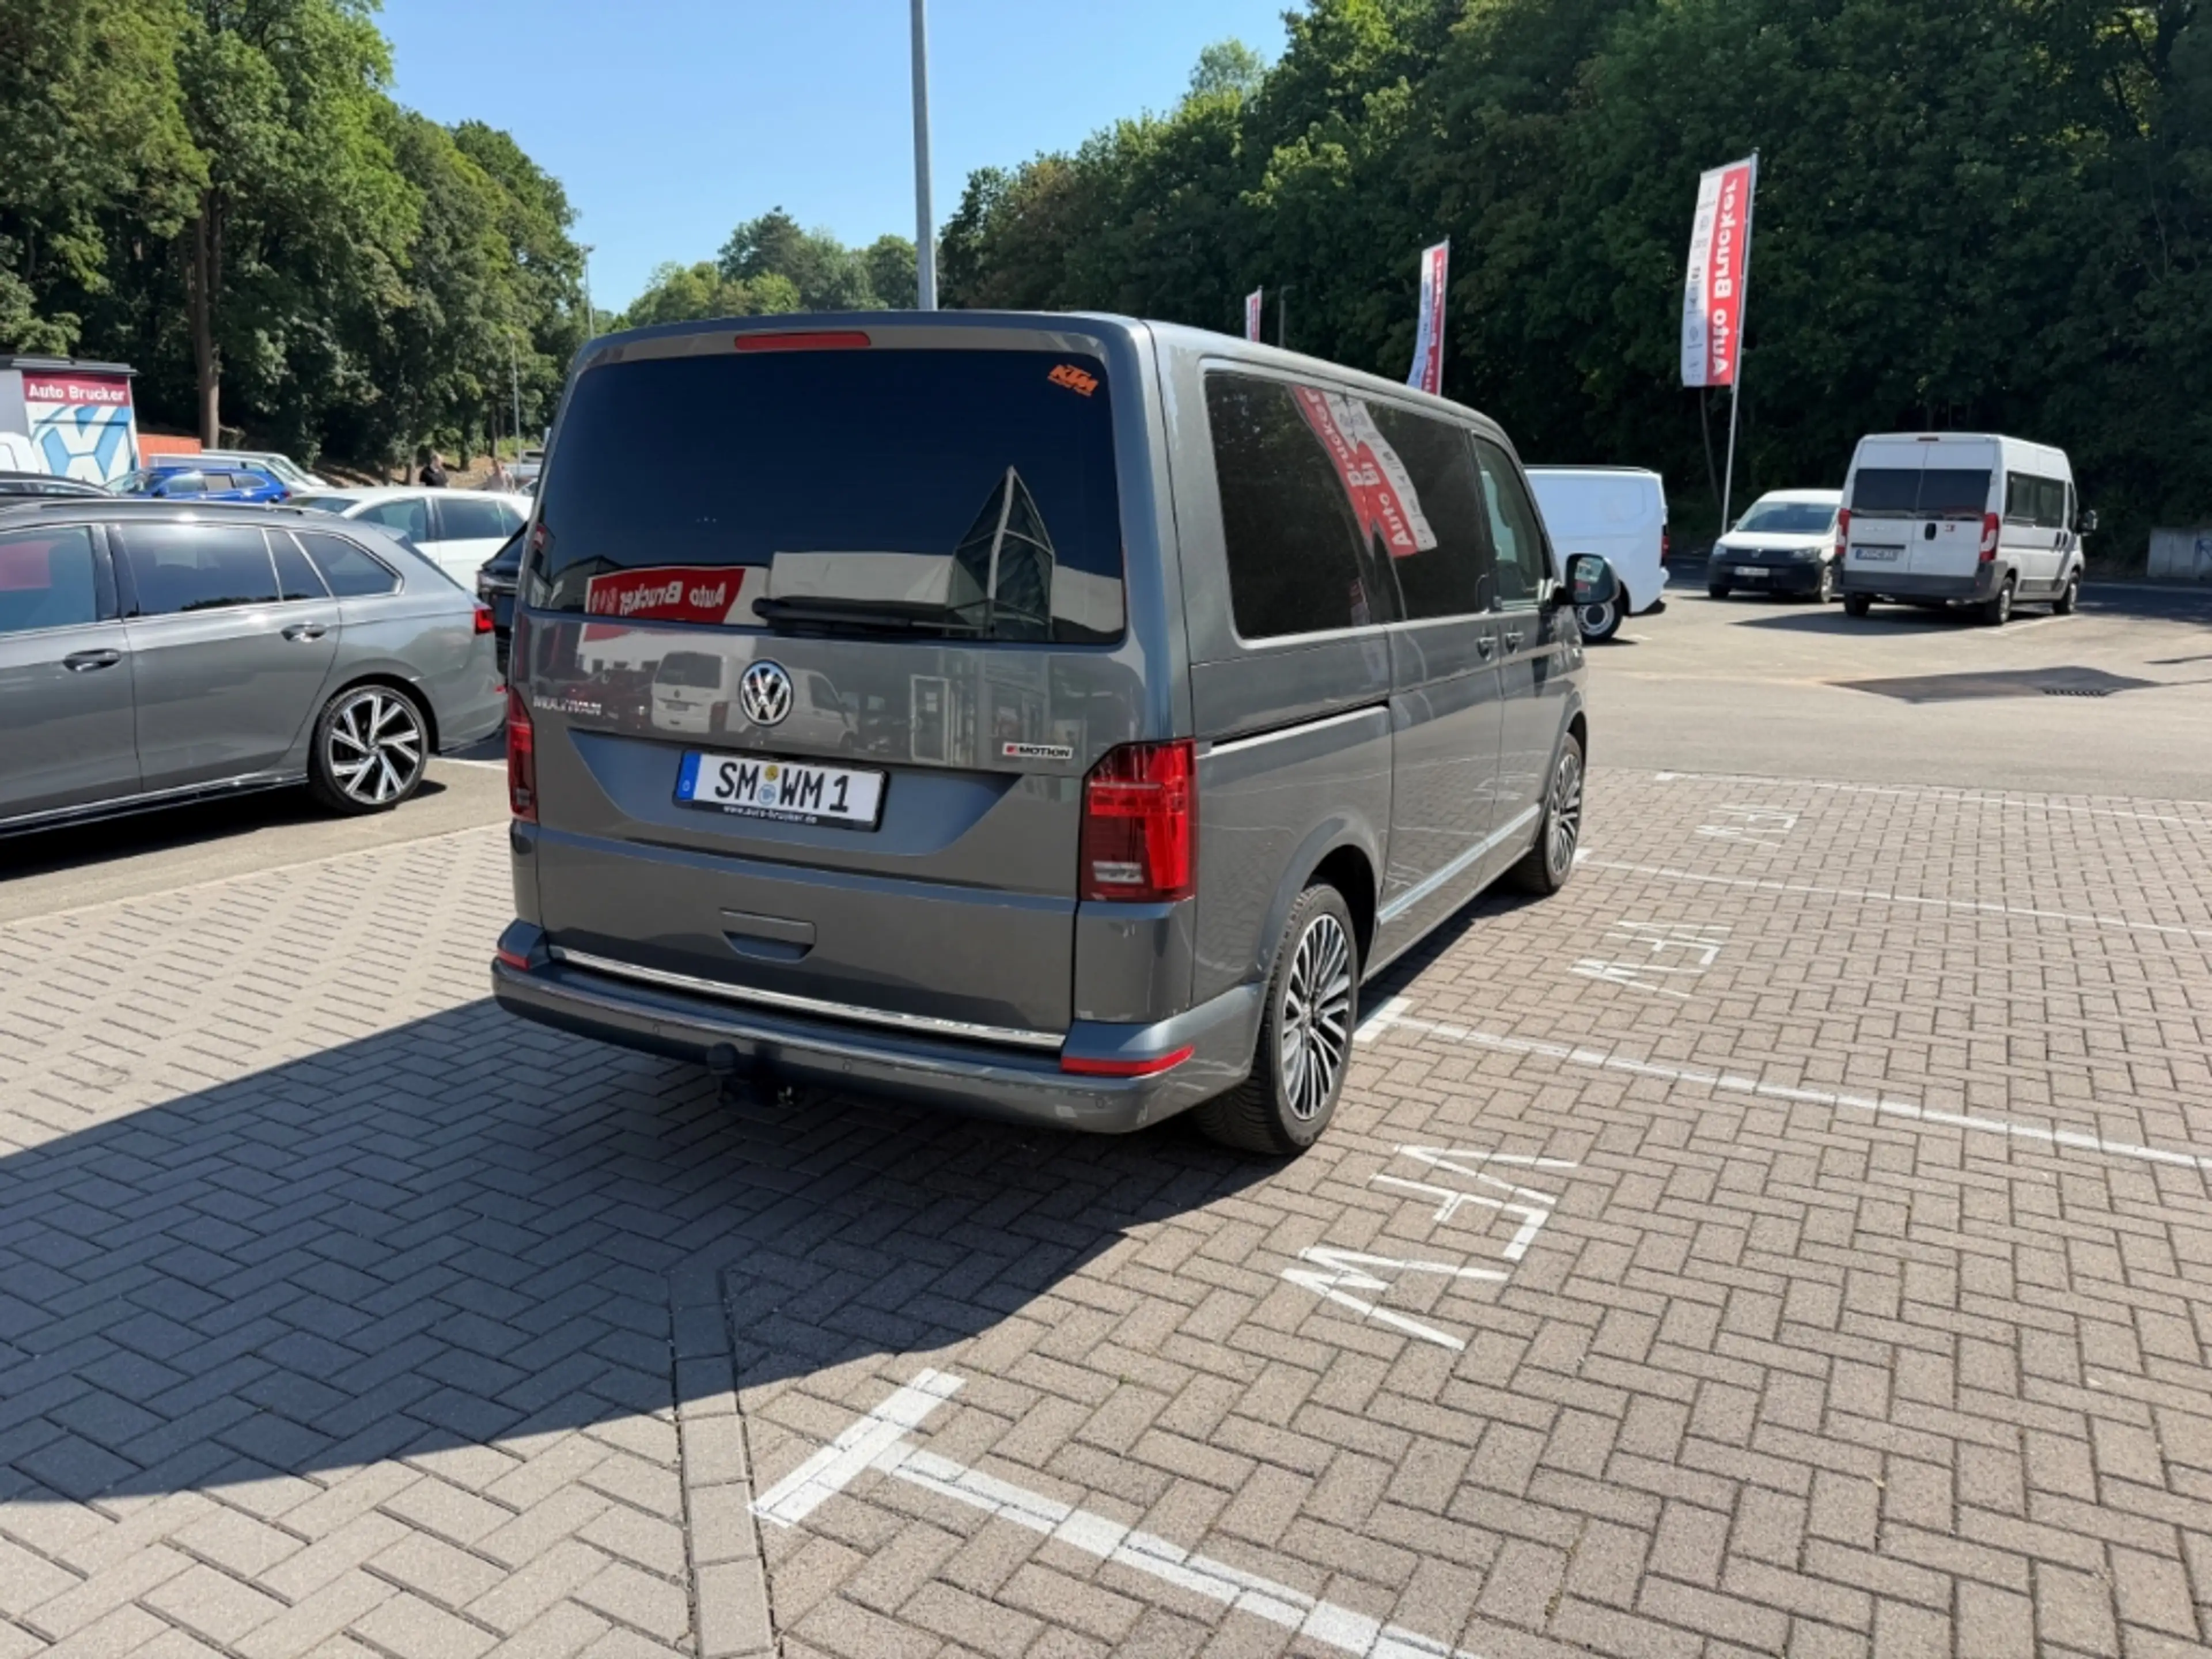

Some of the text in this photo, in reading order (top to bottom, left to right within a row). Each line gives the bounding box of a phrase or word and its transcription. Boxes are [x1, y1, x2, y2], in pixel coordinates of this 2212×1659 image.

[29, 383, 125, 401] Auto Brucker
[1378, 492, 1412, 545] Auto
[715, 762, 849, 813] SM WM 1
[1281, 1143, 1579, 1351] VFW
